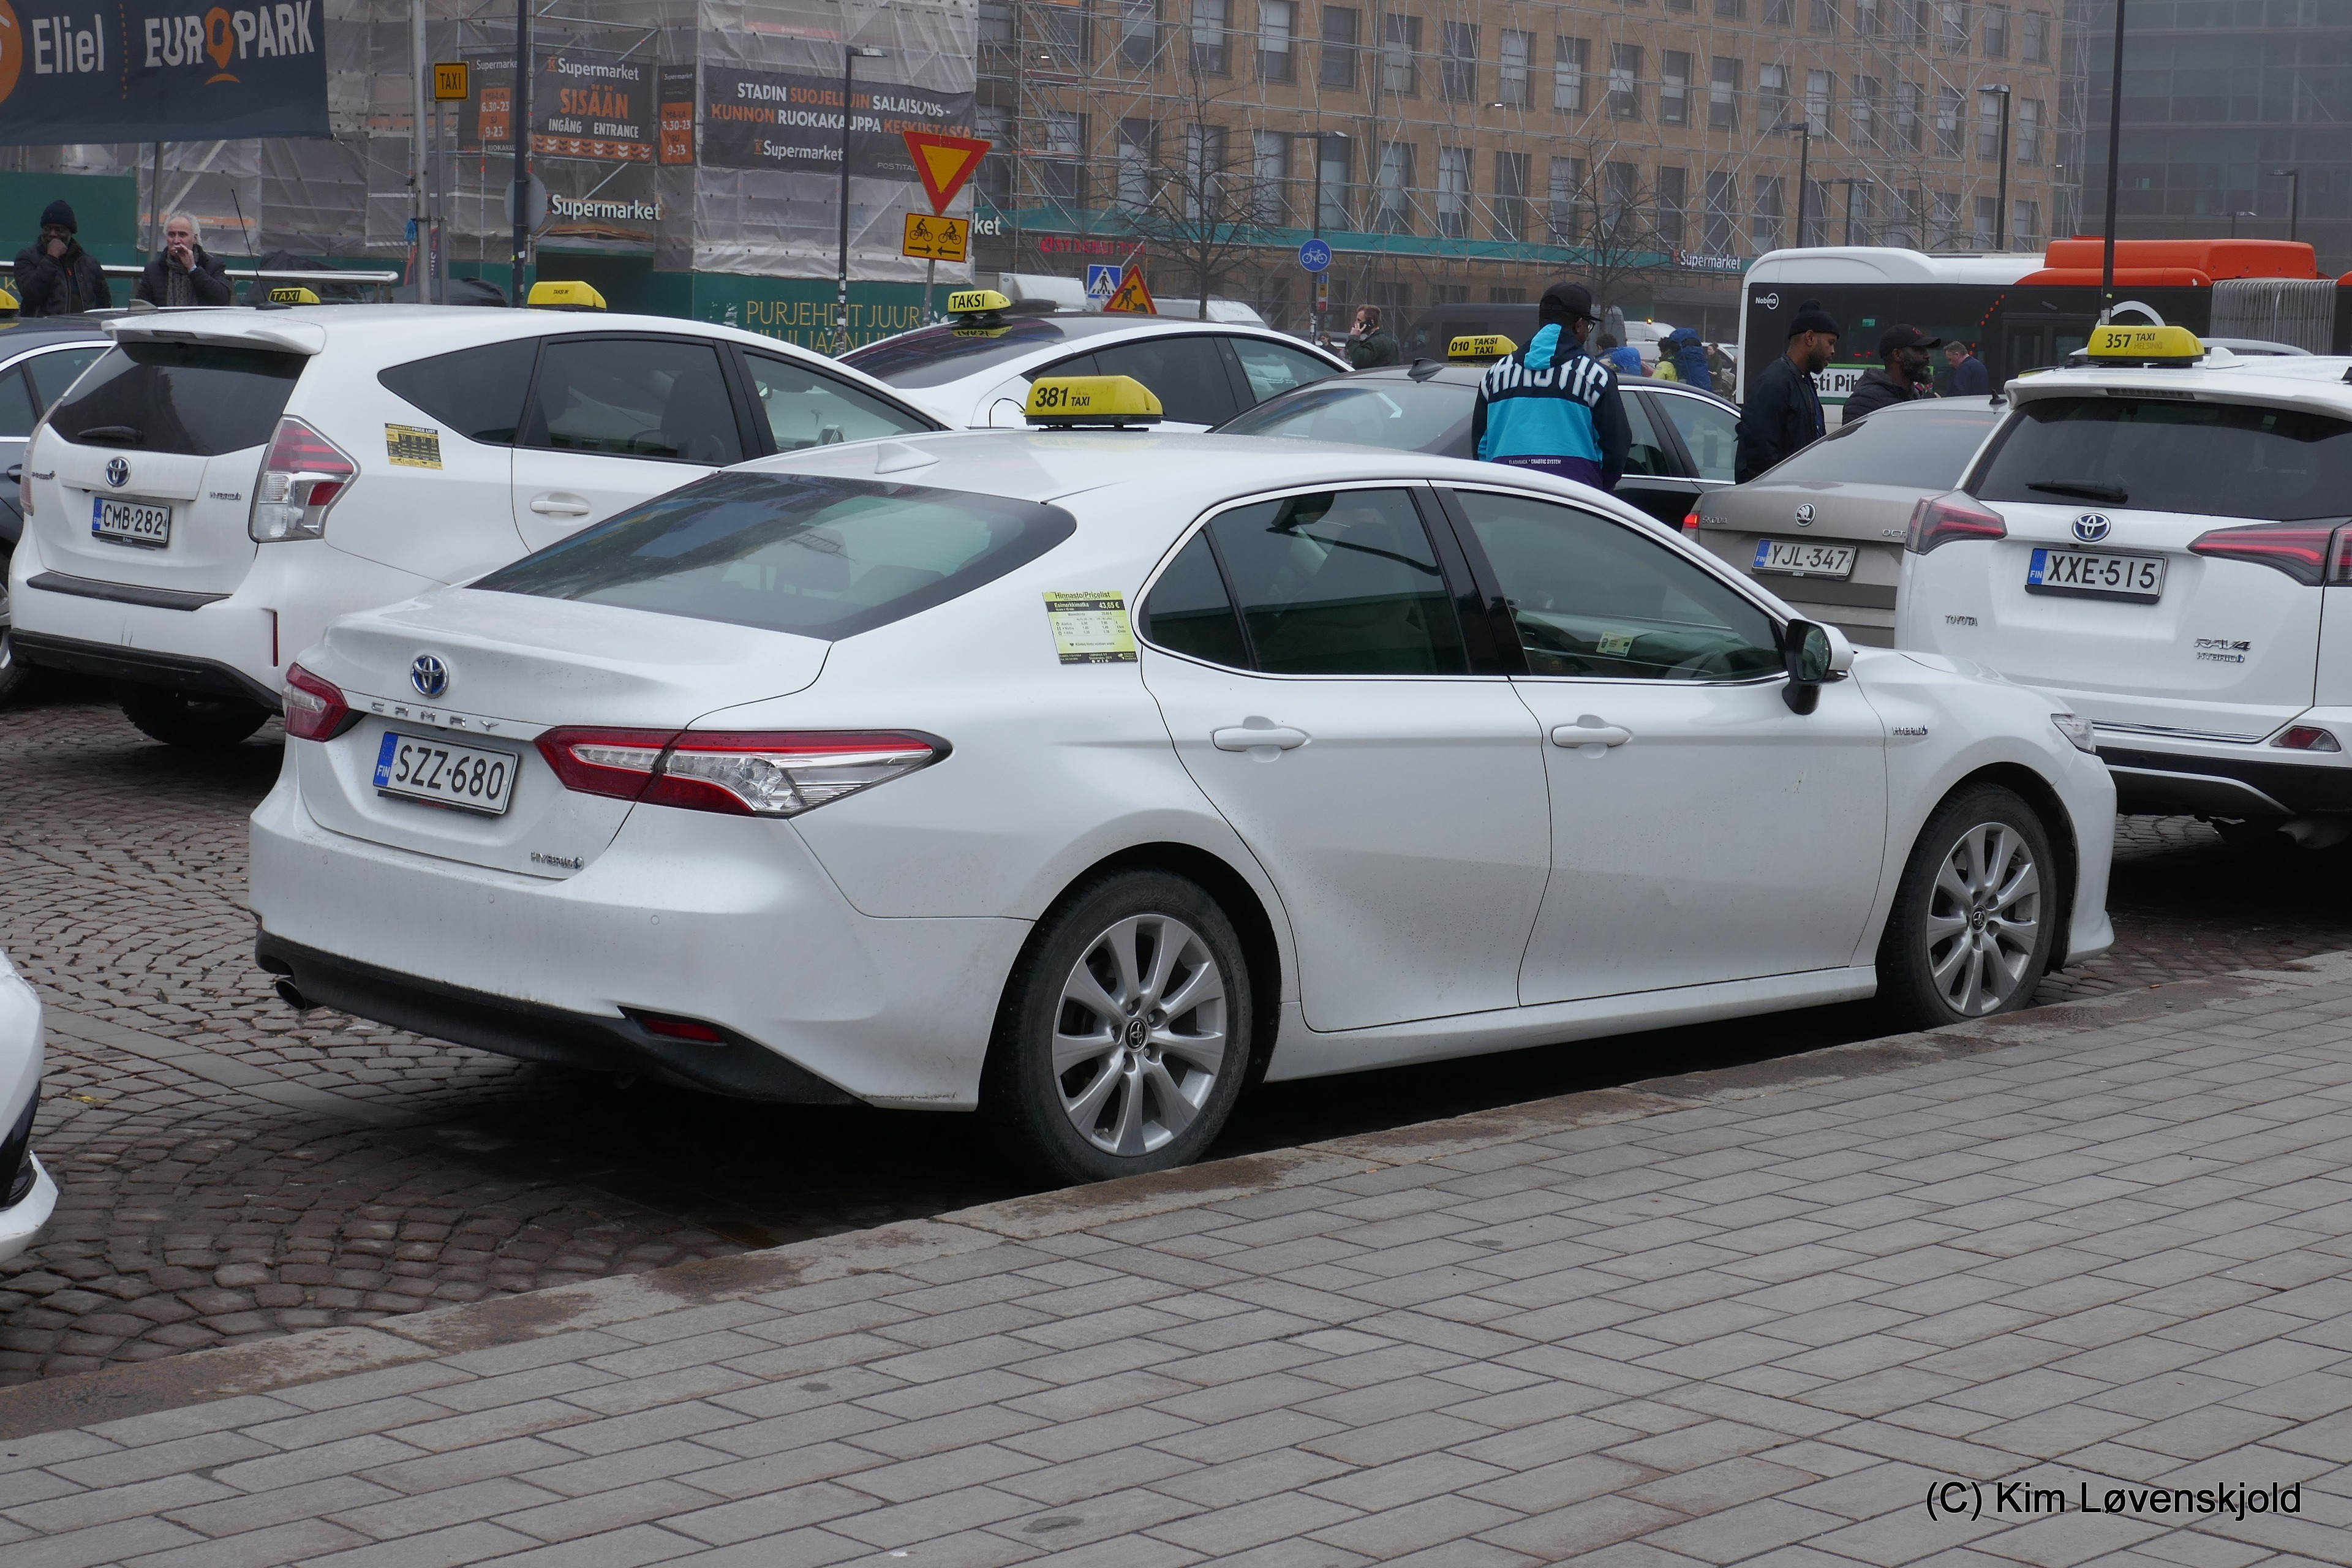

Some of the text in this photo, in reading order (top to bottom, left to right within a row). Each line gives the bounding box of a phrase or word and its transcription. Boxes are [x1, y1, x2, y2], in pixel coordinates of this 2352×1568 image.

[32, 13, 105, 74] Eliel
[145, 1, 315, 69] EUROPARK
[477, 58, 518, 71] Supermarke
[558, 58, 639, 81] Supermarket
[440, 73, 461, 90] TAXI
[481, 102, 510, 112] 6.30-23
[560, 84, 628, 119] SISÄÄN
[737, 82, 787, 102] STADIN
[872, 95, 944, 118] SALAISUUS
[711, 104, 775, 123] KUNNON
[485, 126, 503, 137] 9-23
[548, 118, 639, 138] INGÅNG ENTRANCE
[668, 145, 686, 156] 9-23
[763, 140, 844, 162] Supermarket
[877, 162, 918, 172] POSTITAL
[552, 194, 661, 221] Supermarket
[1680, 249, 1741, 269] Supermarket
[273, 292, 300, 301] TAXI
[952, 294, 985, 309] TAKSI
[747, 301, 924, 328] PURJEHDIT JUUR
[1451, 341, 1469, 352] 010
[2105, 333, 2132, 349] 357
[1474, 346, 1493, 355] TAXI
[1035, 386, 1090, 407] 381 TAXI
[103, 503, 164, 536] CMB-282
[1882, 529, 1905, 538] OCT
[1772, 545, 1849, 570] YJL-347
[2030, 570, 2043, 579] FIN
[2048, 555, 2156, 589] XXE-515
[1945, 615, 1978, 627] TOYOTA
[2194, 637, 2251, 652] RAV4
[2196, 652, 2237, 663] HYBRID
[371, 702, 499, 731] CAMRY
[377, 764, 390, 778] FIN
[396, 744, 505, 800] SZZ-680
